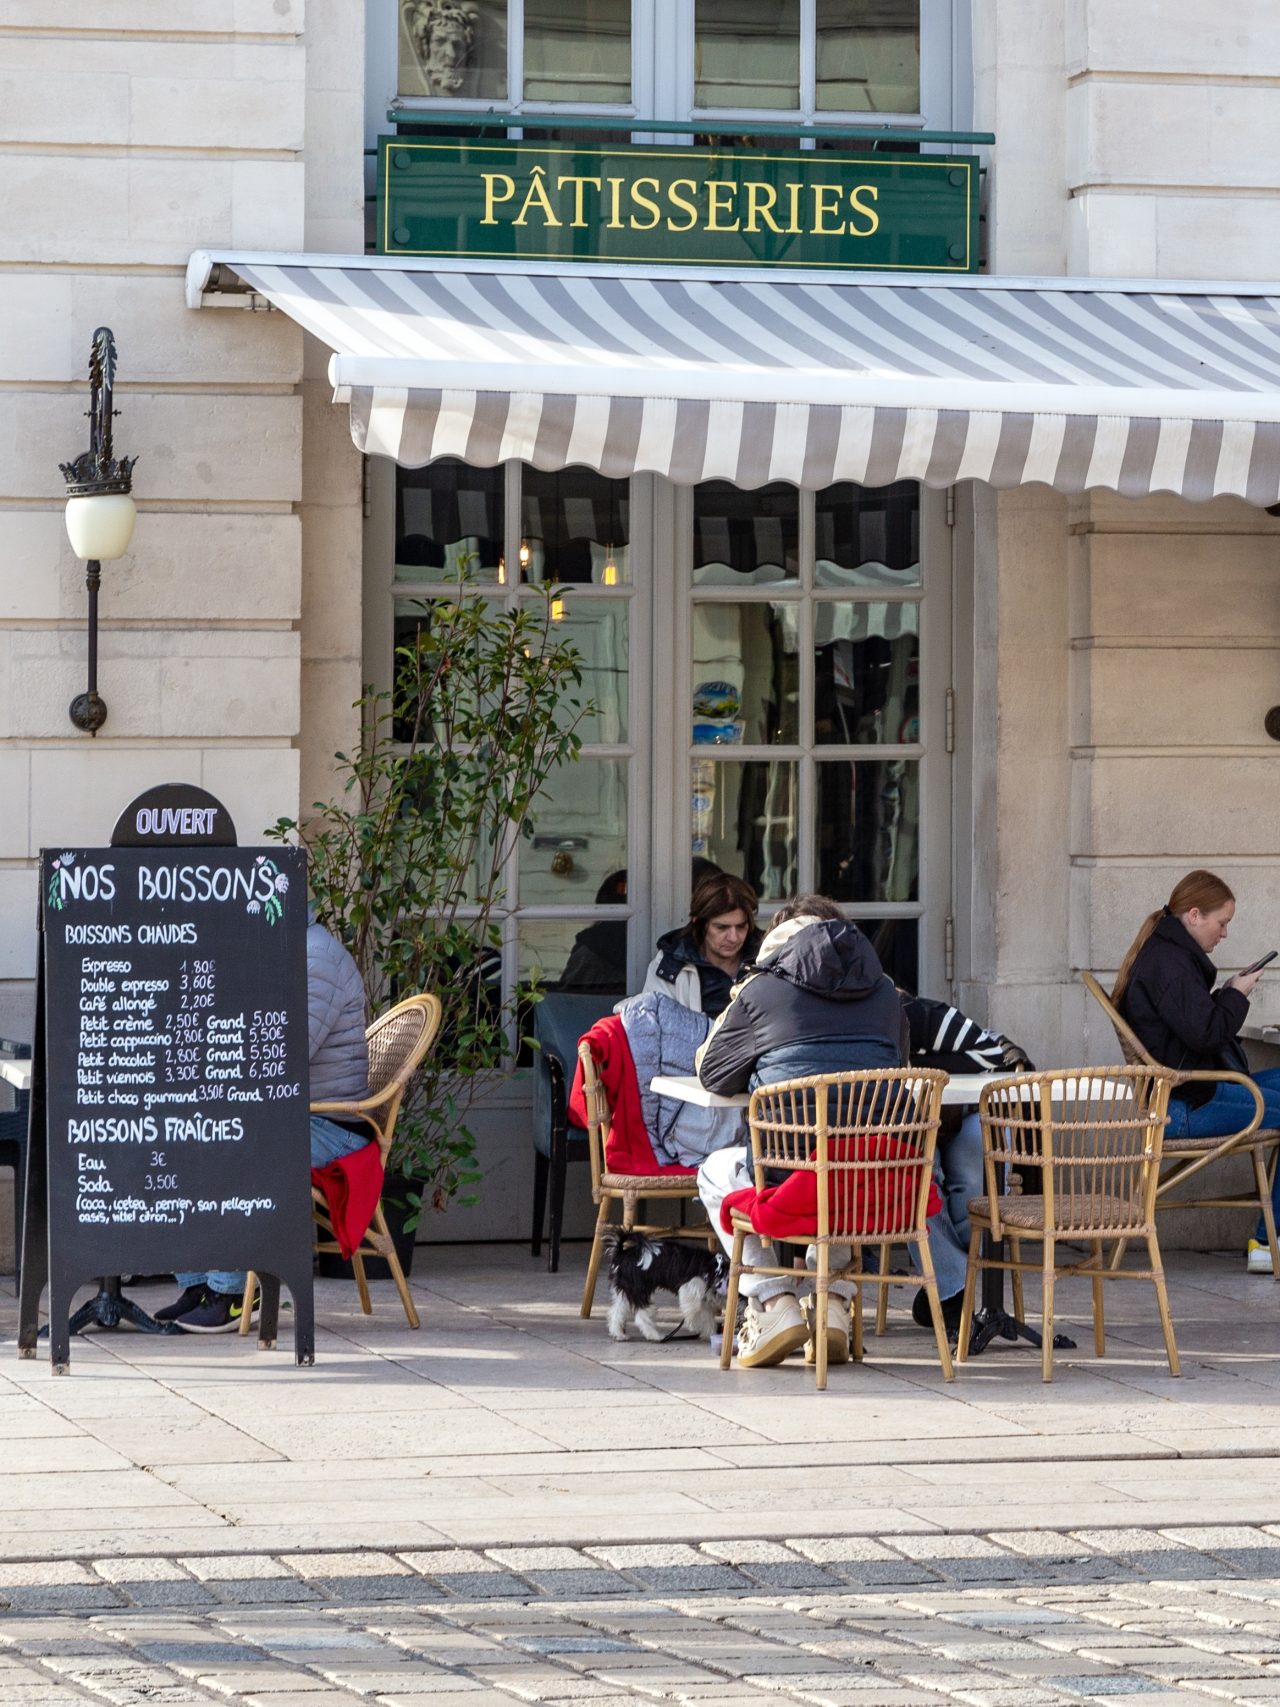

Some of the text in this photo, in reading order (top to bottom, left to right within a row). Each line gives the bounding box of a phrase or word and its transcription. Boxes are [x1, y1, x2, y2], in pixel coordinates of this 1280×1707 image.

[479, 165, 880, 237] PÂTISSERIES
[136, 808, 217, 834] OUVERT
[59, 864, 275, 902] NOS BOISSONS
[65, 923, 198, 944] BOISSONS CHAUDES
[82, 957, 132, 979] Expresso
[81, 975, 215, 998] Double expresso 3,60€
[80, 993, 215, 1017] Café allongé 2,20€
[81, 1015, 109, 1031] Petit
[113, 1015, 154, 1031] crème
[165, 1012, 200, 1031] 2,50€
[206, 1012, 247, 1029] Grand
[80, 1032, 107, 1049] Petit
[111, 1033, 172, 1052] cappuccino
[175, 1028, 204, 1046] 2,80€
[206, 1031, 244, 1044] Grand
[78, 1052, 105, 1067] Petit
[108, 1052, 156, 1067] chocolat
[165, 1047, 201, 1064] 2,80€
[206, 1046, 246, 1061] Grand
[77, 1061, 286, 1085] Petit viennois 3,30€ Grand 6,50€
[77, 1088, 105, 1105] Petit
[108, 1089, 139, 1105] choco
[144, 1088, 199, 1110] gourmand
[227, 1085, 264, 1101] Grand
[68, 1112, 244, 1143] BOISSONS FRAÎCHES
[78, 1151, 167, 1171] Eau 3€
[78, 1174, 178, 1192] Soda 3,50€
[197, 1200, 217, 1211] san
